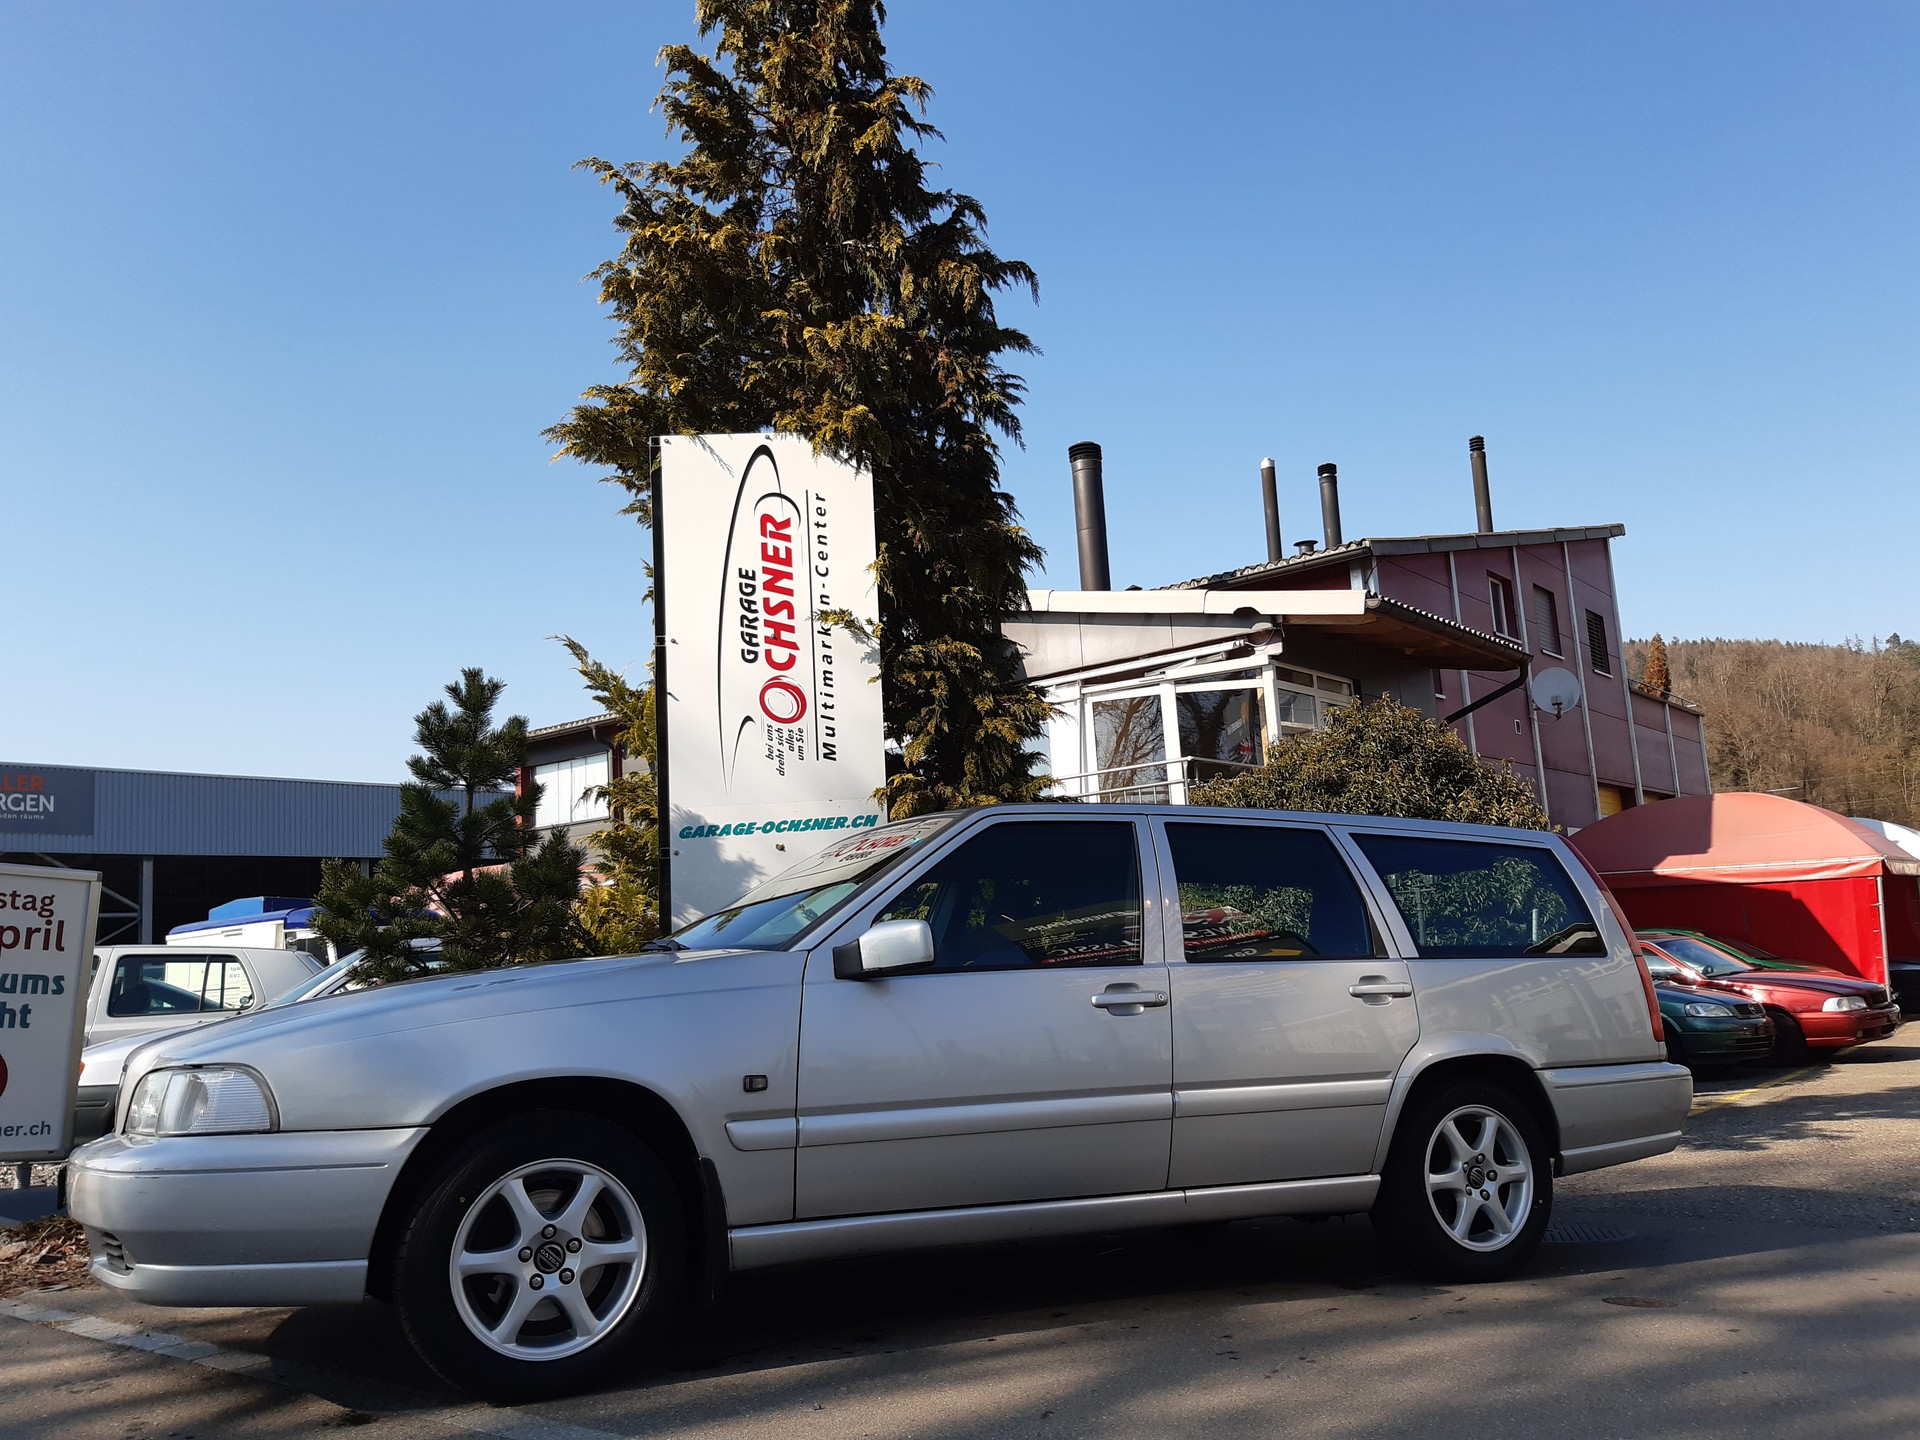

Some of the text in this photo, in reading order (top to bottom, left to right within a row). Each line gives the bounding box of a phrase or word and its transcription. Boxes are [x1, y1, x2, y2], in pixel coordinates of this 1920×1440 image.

[738, 567, 760, 664] GARAGE
[759, 513, 807, 724] OCHSNER
[813, 493, 837, 763] Multimarkn-Center
[765, 723, 774, 761] bei uns
[774, 727, 785, 776] dreht sich
[785, 728, 795, 752] alles
[795, 727, 805, 761] um Sie
[0, 774, 43, 792] LER
[678, 814, 879, 840] GARAGE-OCHSNER.CH
[540, 1249, 559, 1267] VOLVO
